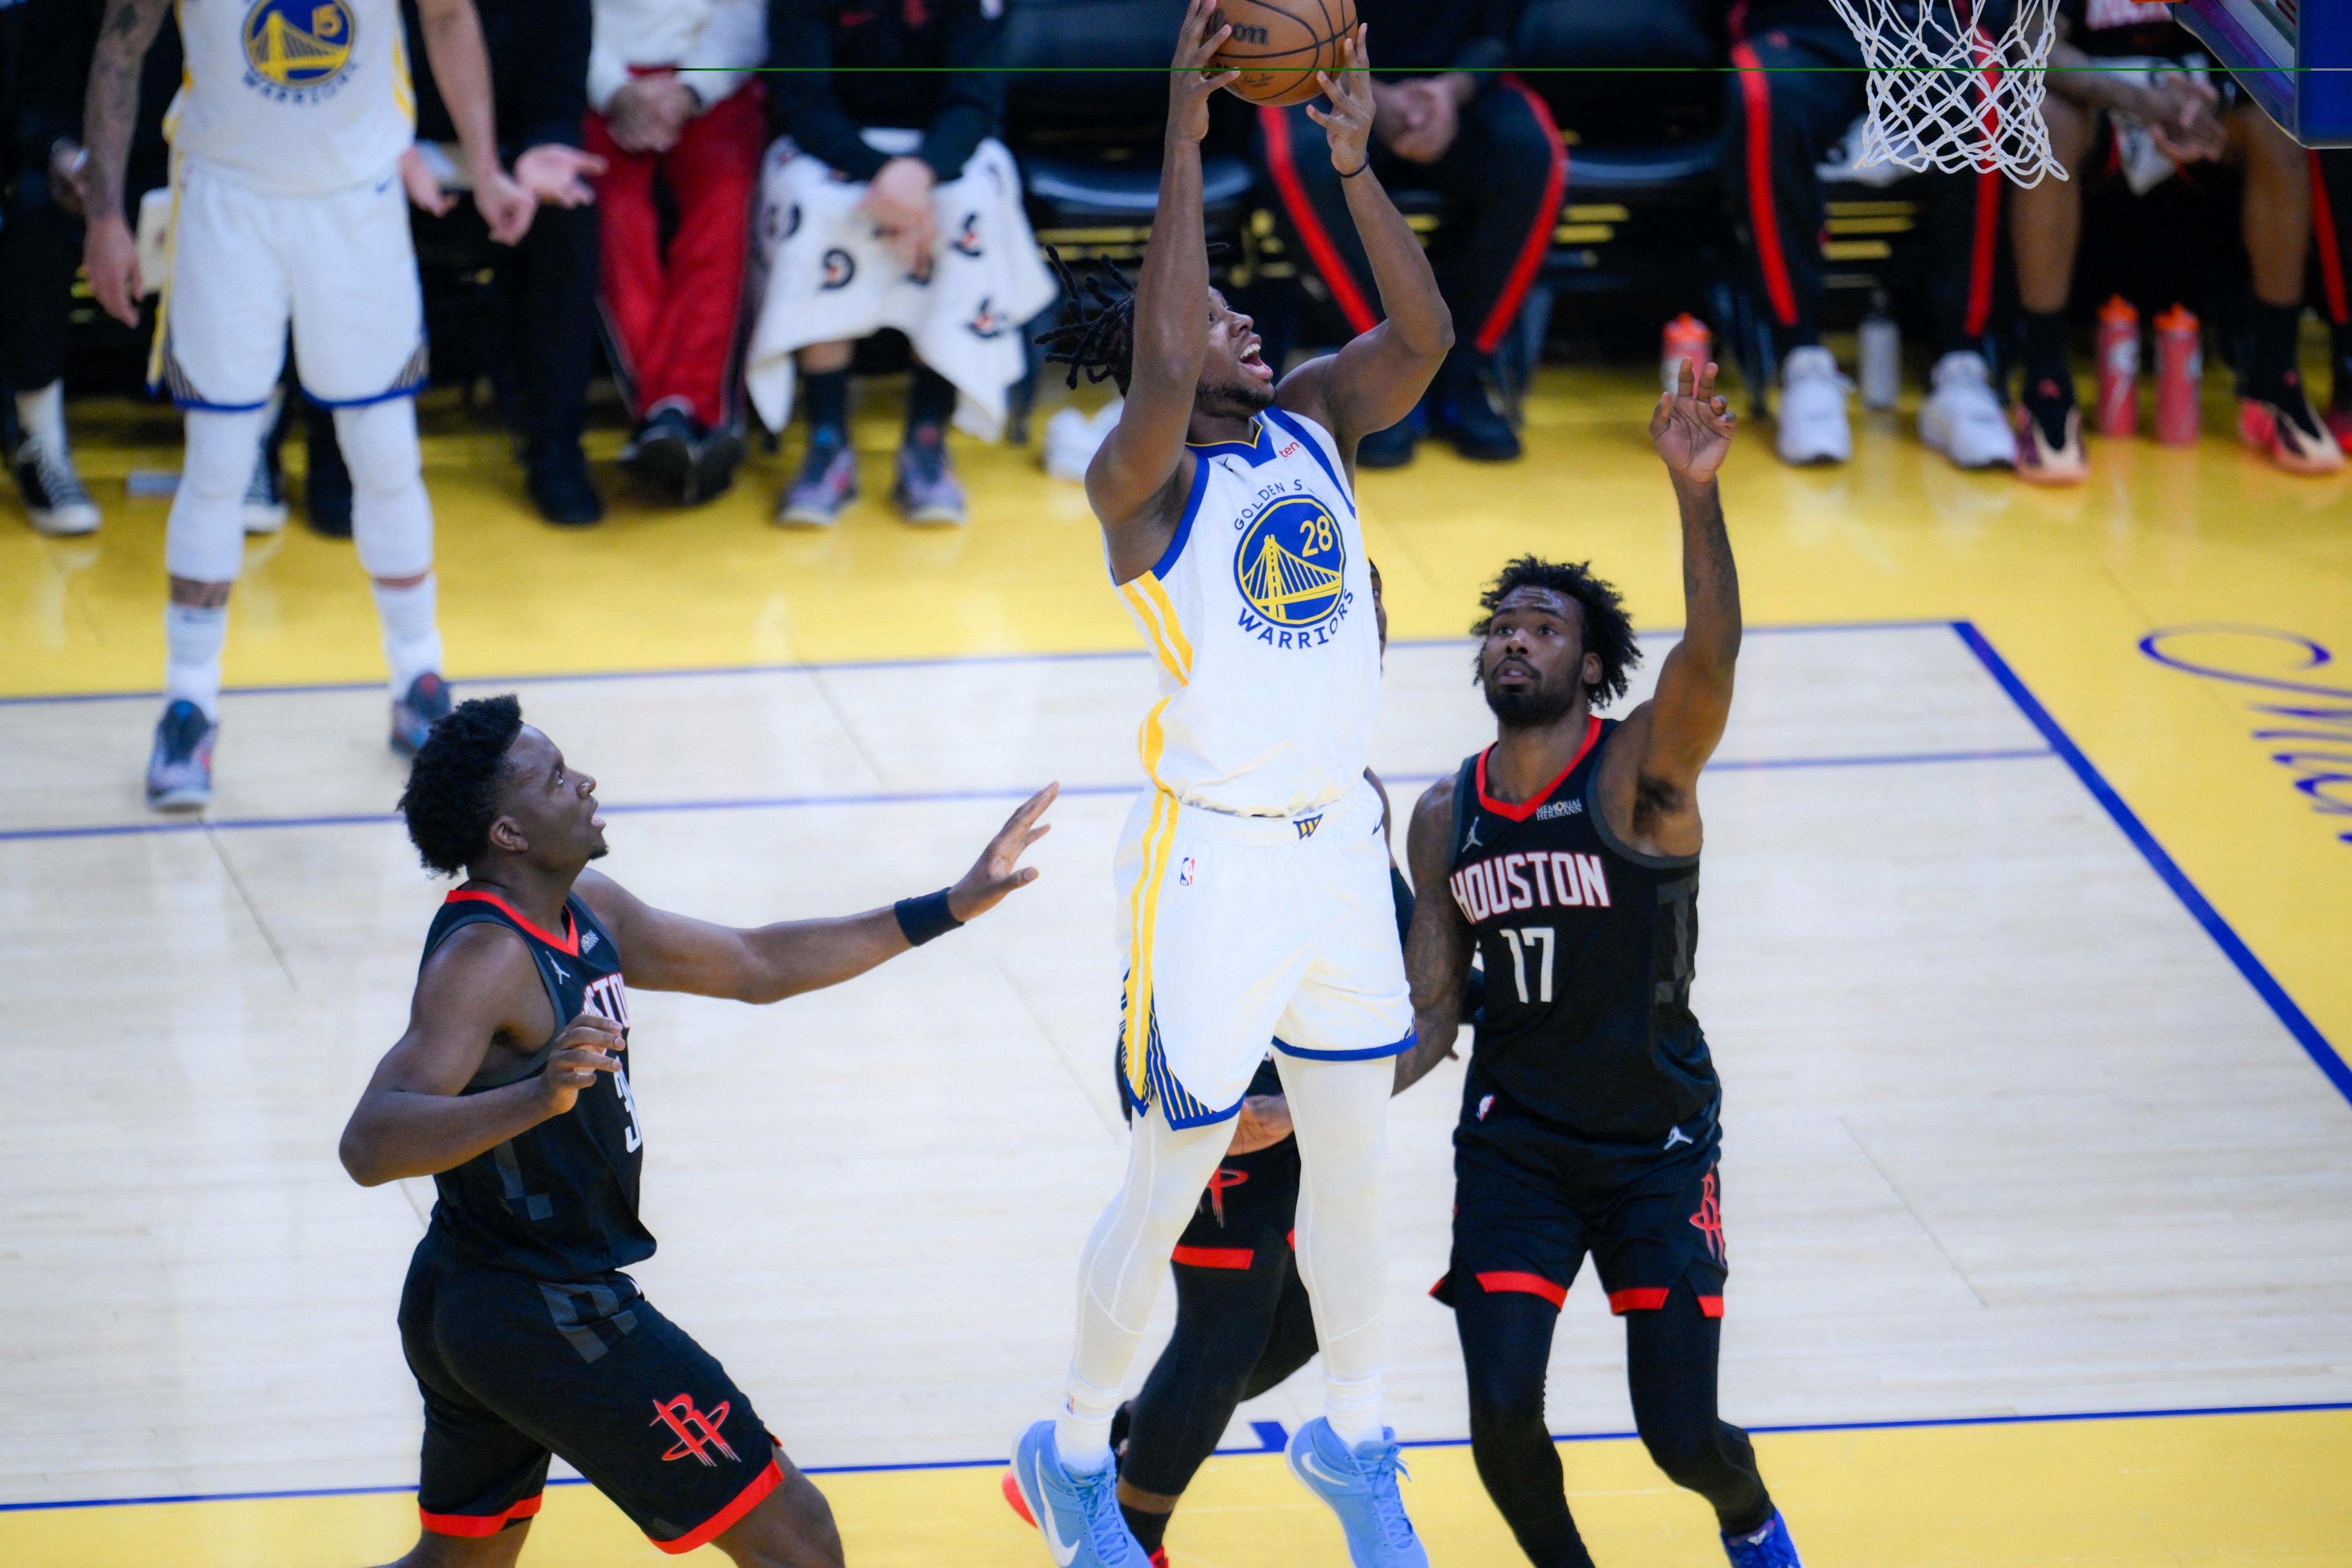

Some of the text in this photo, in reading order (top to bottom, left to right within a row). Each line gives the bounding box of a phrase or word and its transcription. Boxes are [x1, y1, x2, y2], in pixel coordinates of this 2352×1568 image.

[1234, 482, 1286, 531] GOLDEN
[1300, 515, 1334, 558] 28
[1237, 588, 1354, 649] WARRIORS
[1449, 851, 1612, 926] HOUSTON
[1499, 927, 1554, 1004] 17
[613, 1055, 643, 1153] 3
